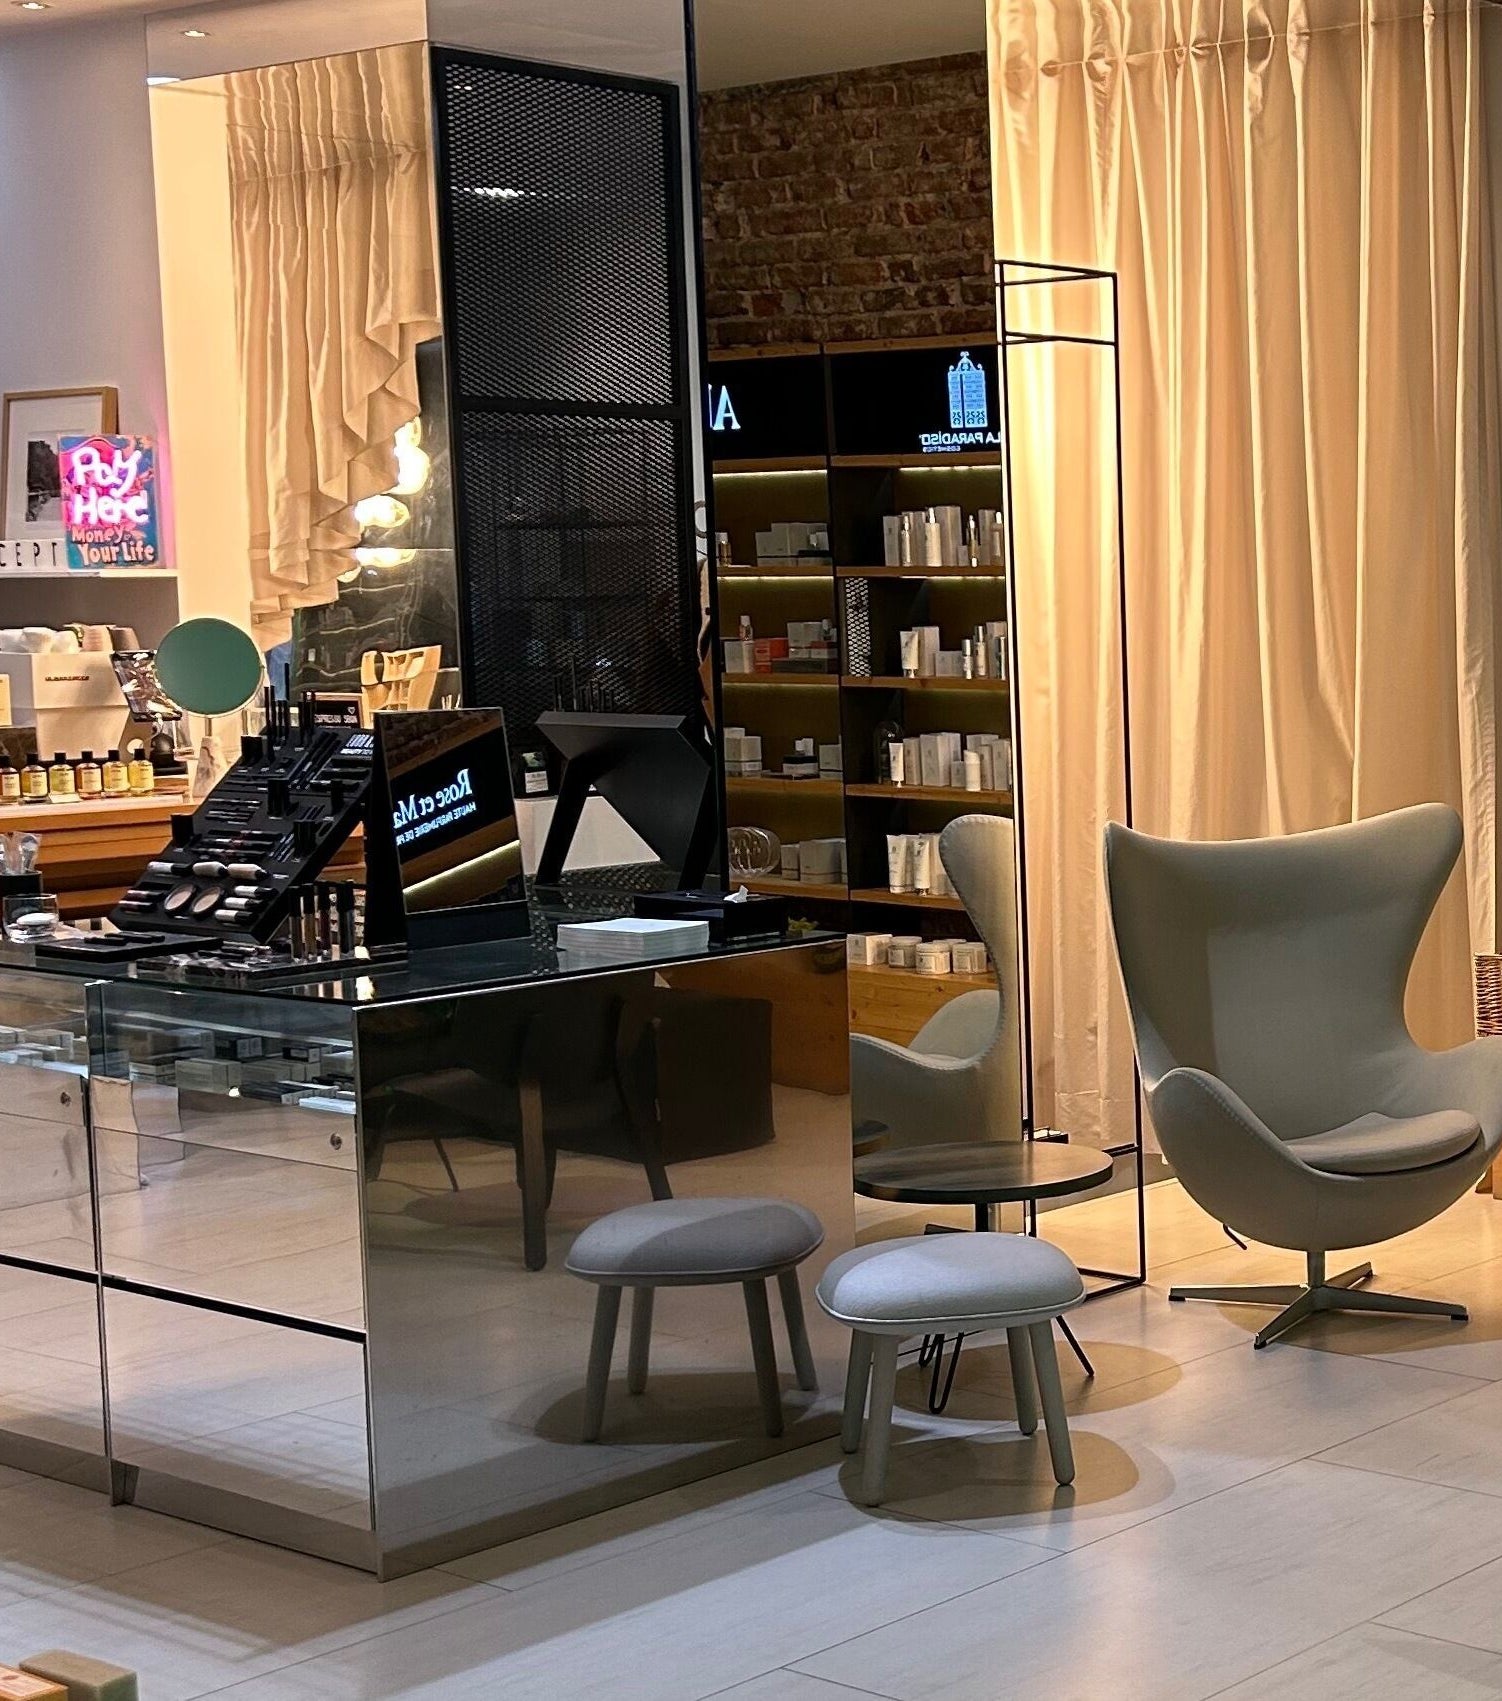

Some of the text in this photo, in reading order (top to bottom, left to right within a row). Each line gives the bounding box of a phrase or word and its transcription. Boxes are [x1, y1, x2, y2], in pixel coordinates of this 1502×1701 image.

[72, 446, 142, 497] Pay
[73, 486, 149, 525] Here
[71, 525, 125, 543] Money
[78, 541, 155, 566] Your Life
